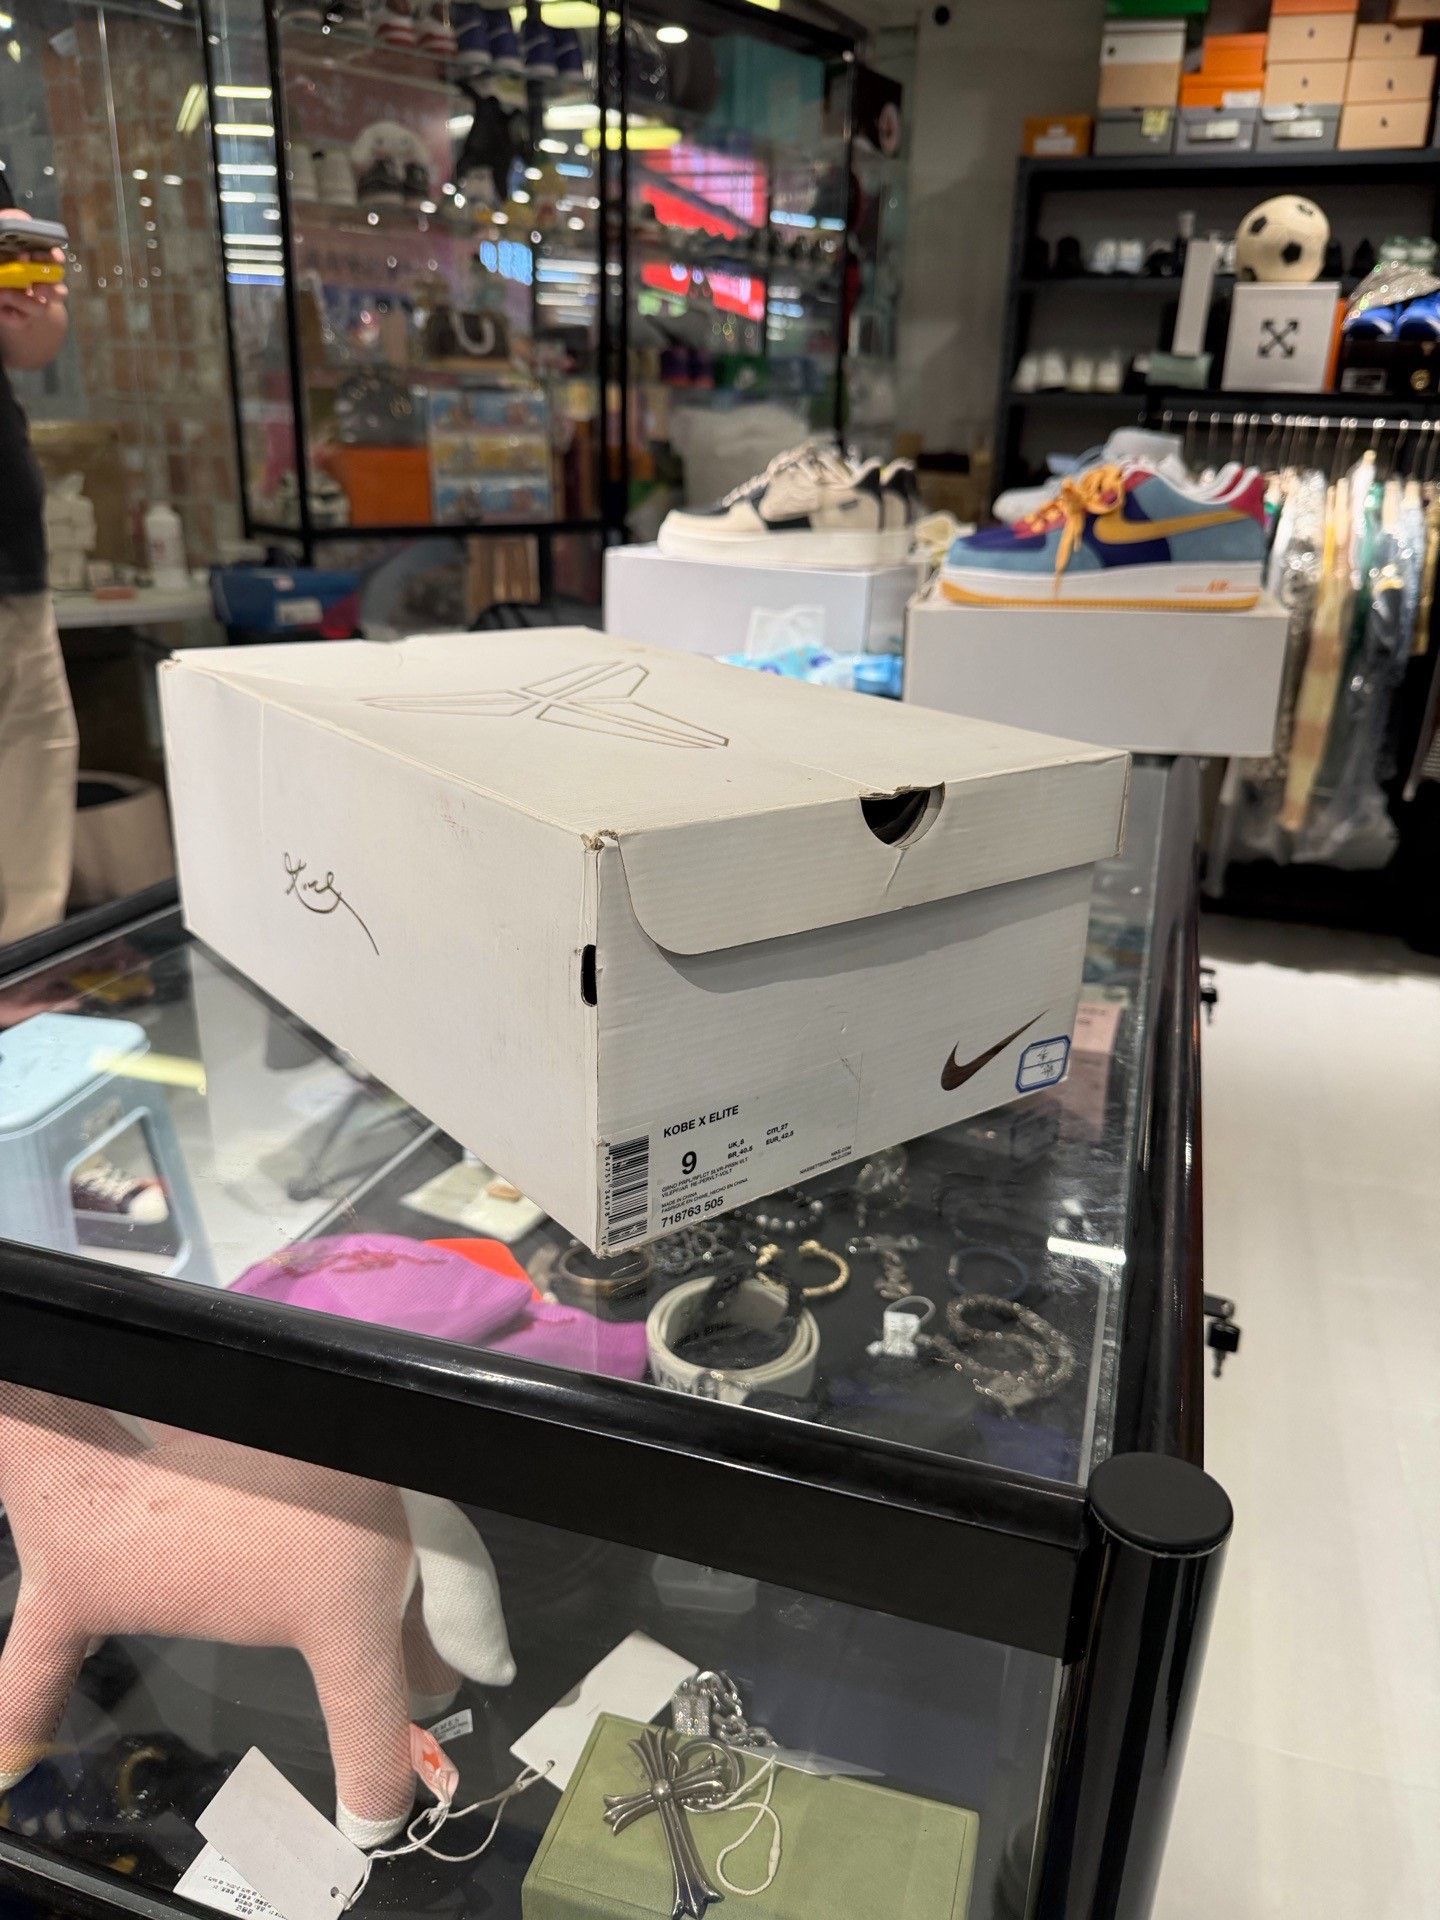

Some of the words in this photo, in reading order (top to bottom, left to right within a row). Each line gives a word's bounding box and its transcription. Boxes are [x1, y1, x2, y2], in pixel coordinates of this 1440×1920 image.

[663, 1119, 696, 1138] KOBE
[698, 1116, 706, 1126] X
[709, 1105, 739, 1122] ELITE
[681, 1150, 698, 1175] 9
[661, 1205, 701, 1228] 718763
[704, 1196, 724, 1211] 505
